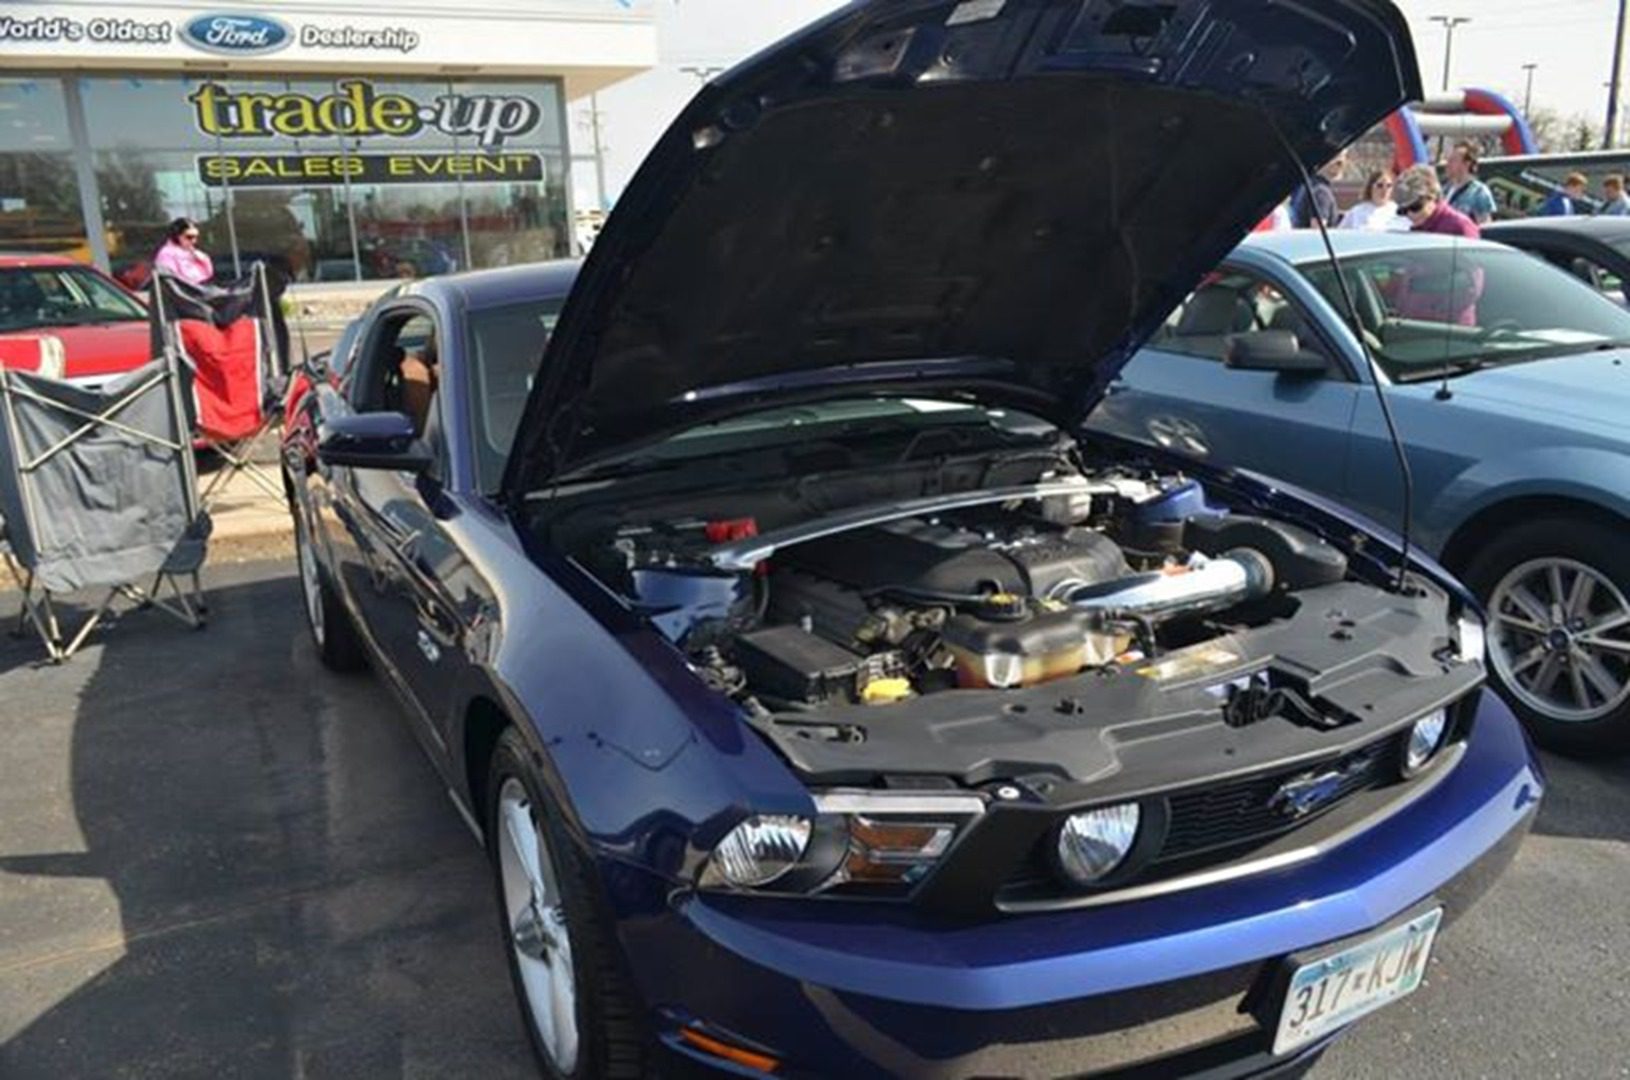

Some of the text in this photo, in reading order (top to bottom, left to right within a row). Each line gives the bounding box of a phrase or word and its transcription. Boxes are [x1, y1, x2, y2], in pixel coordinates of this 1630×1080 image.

[88, 18, 171, 42] Oldest
[205, 17, 270, 46] Ford
[301, 26, 419, 52] Dealership
[205, 157, 532, 178] SALES EVENT
